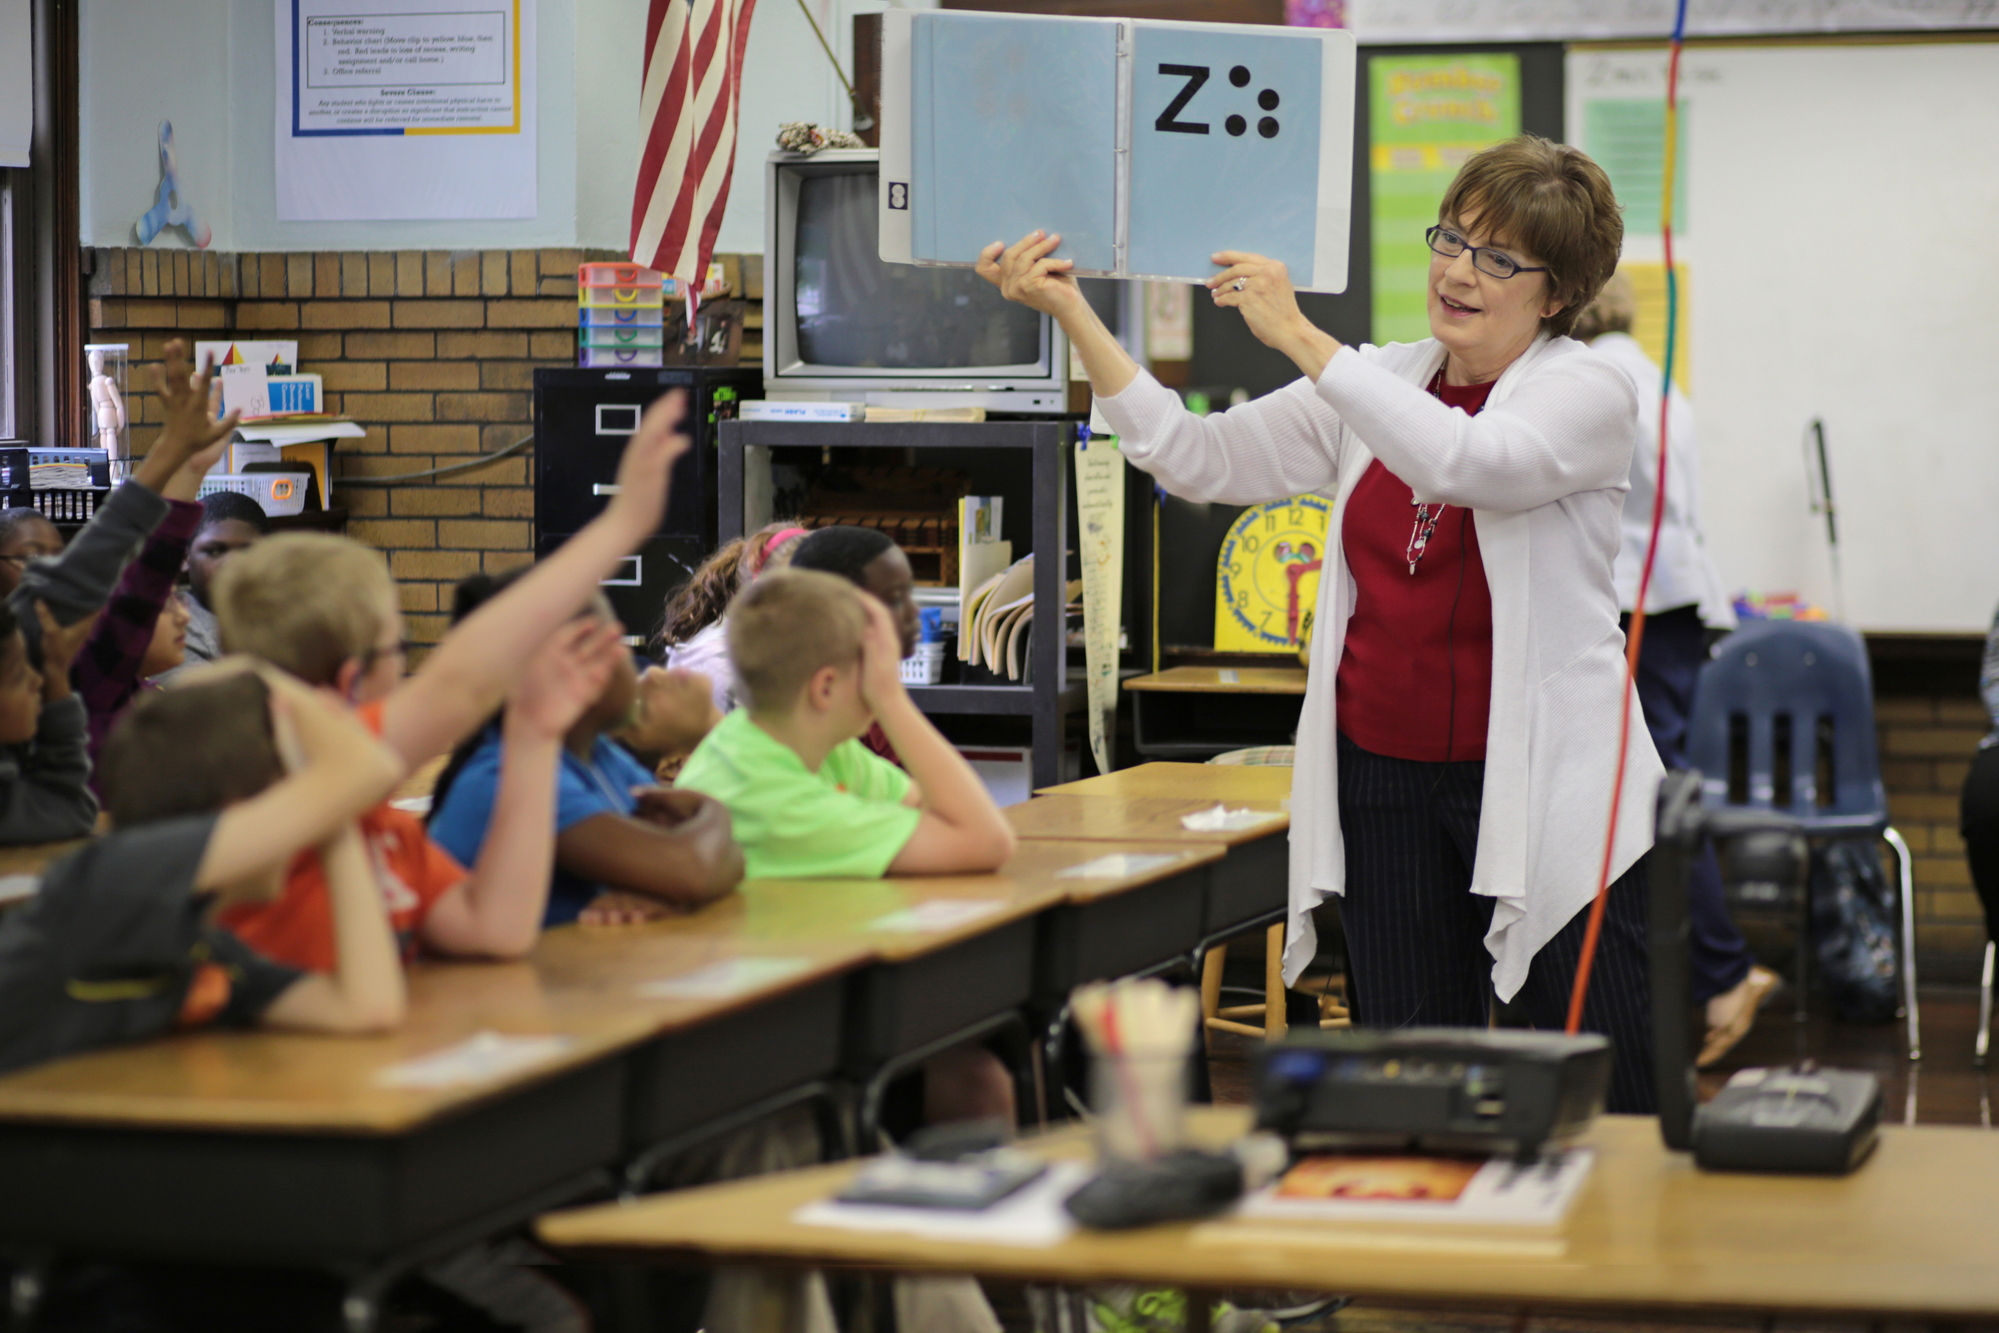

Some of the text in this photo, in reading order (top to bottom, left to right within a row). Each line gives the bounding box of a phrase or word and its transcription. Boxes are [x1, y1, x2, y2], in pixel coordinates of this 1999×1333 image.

[307, 18, 364, 27] Consequences:
[357, 28, 385, 36] warning
[355, 47, 369, 55] Red
[399, 46, 413, 54] loss
[423, 46, 448, 54] recess,
[450, 45, 476, 54] writing
[338, 57, 377, 67] assignment
[404, 56, 417, 64] call
[419, 56, 444, 65] home.)
[332, 67, 354, 75] Office
[355, 67, 381, 75] referral
[381, 88, 437, 97] Severe Clause:
[1155, 63, 1210, 135] Z
[1265, 514, 1276, 532] 11
[1288, 508, 1303, 526] 12
[1318, 515, 1325, 533] 1
[1240, 535, 1259, 553] 10
[1229, 562, 1242, 580] 9
[1237, 590, 1249, 608] 8
[1261, 611, 1273, 633] 7
